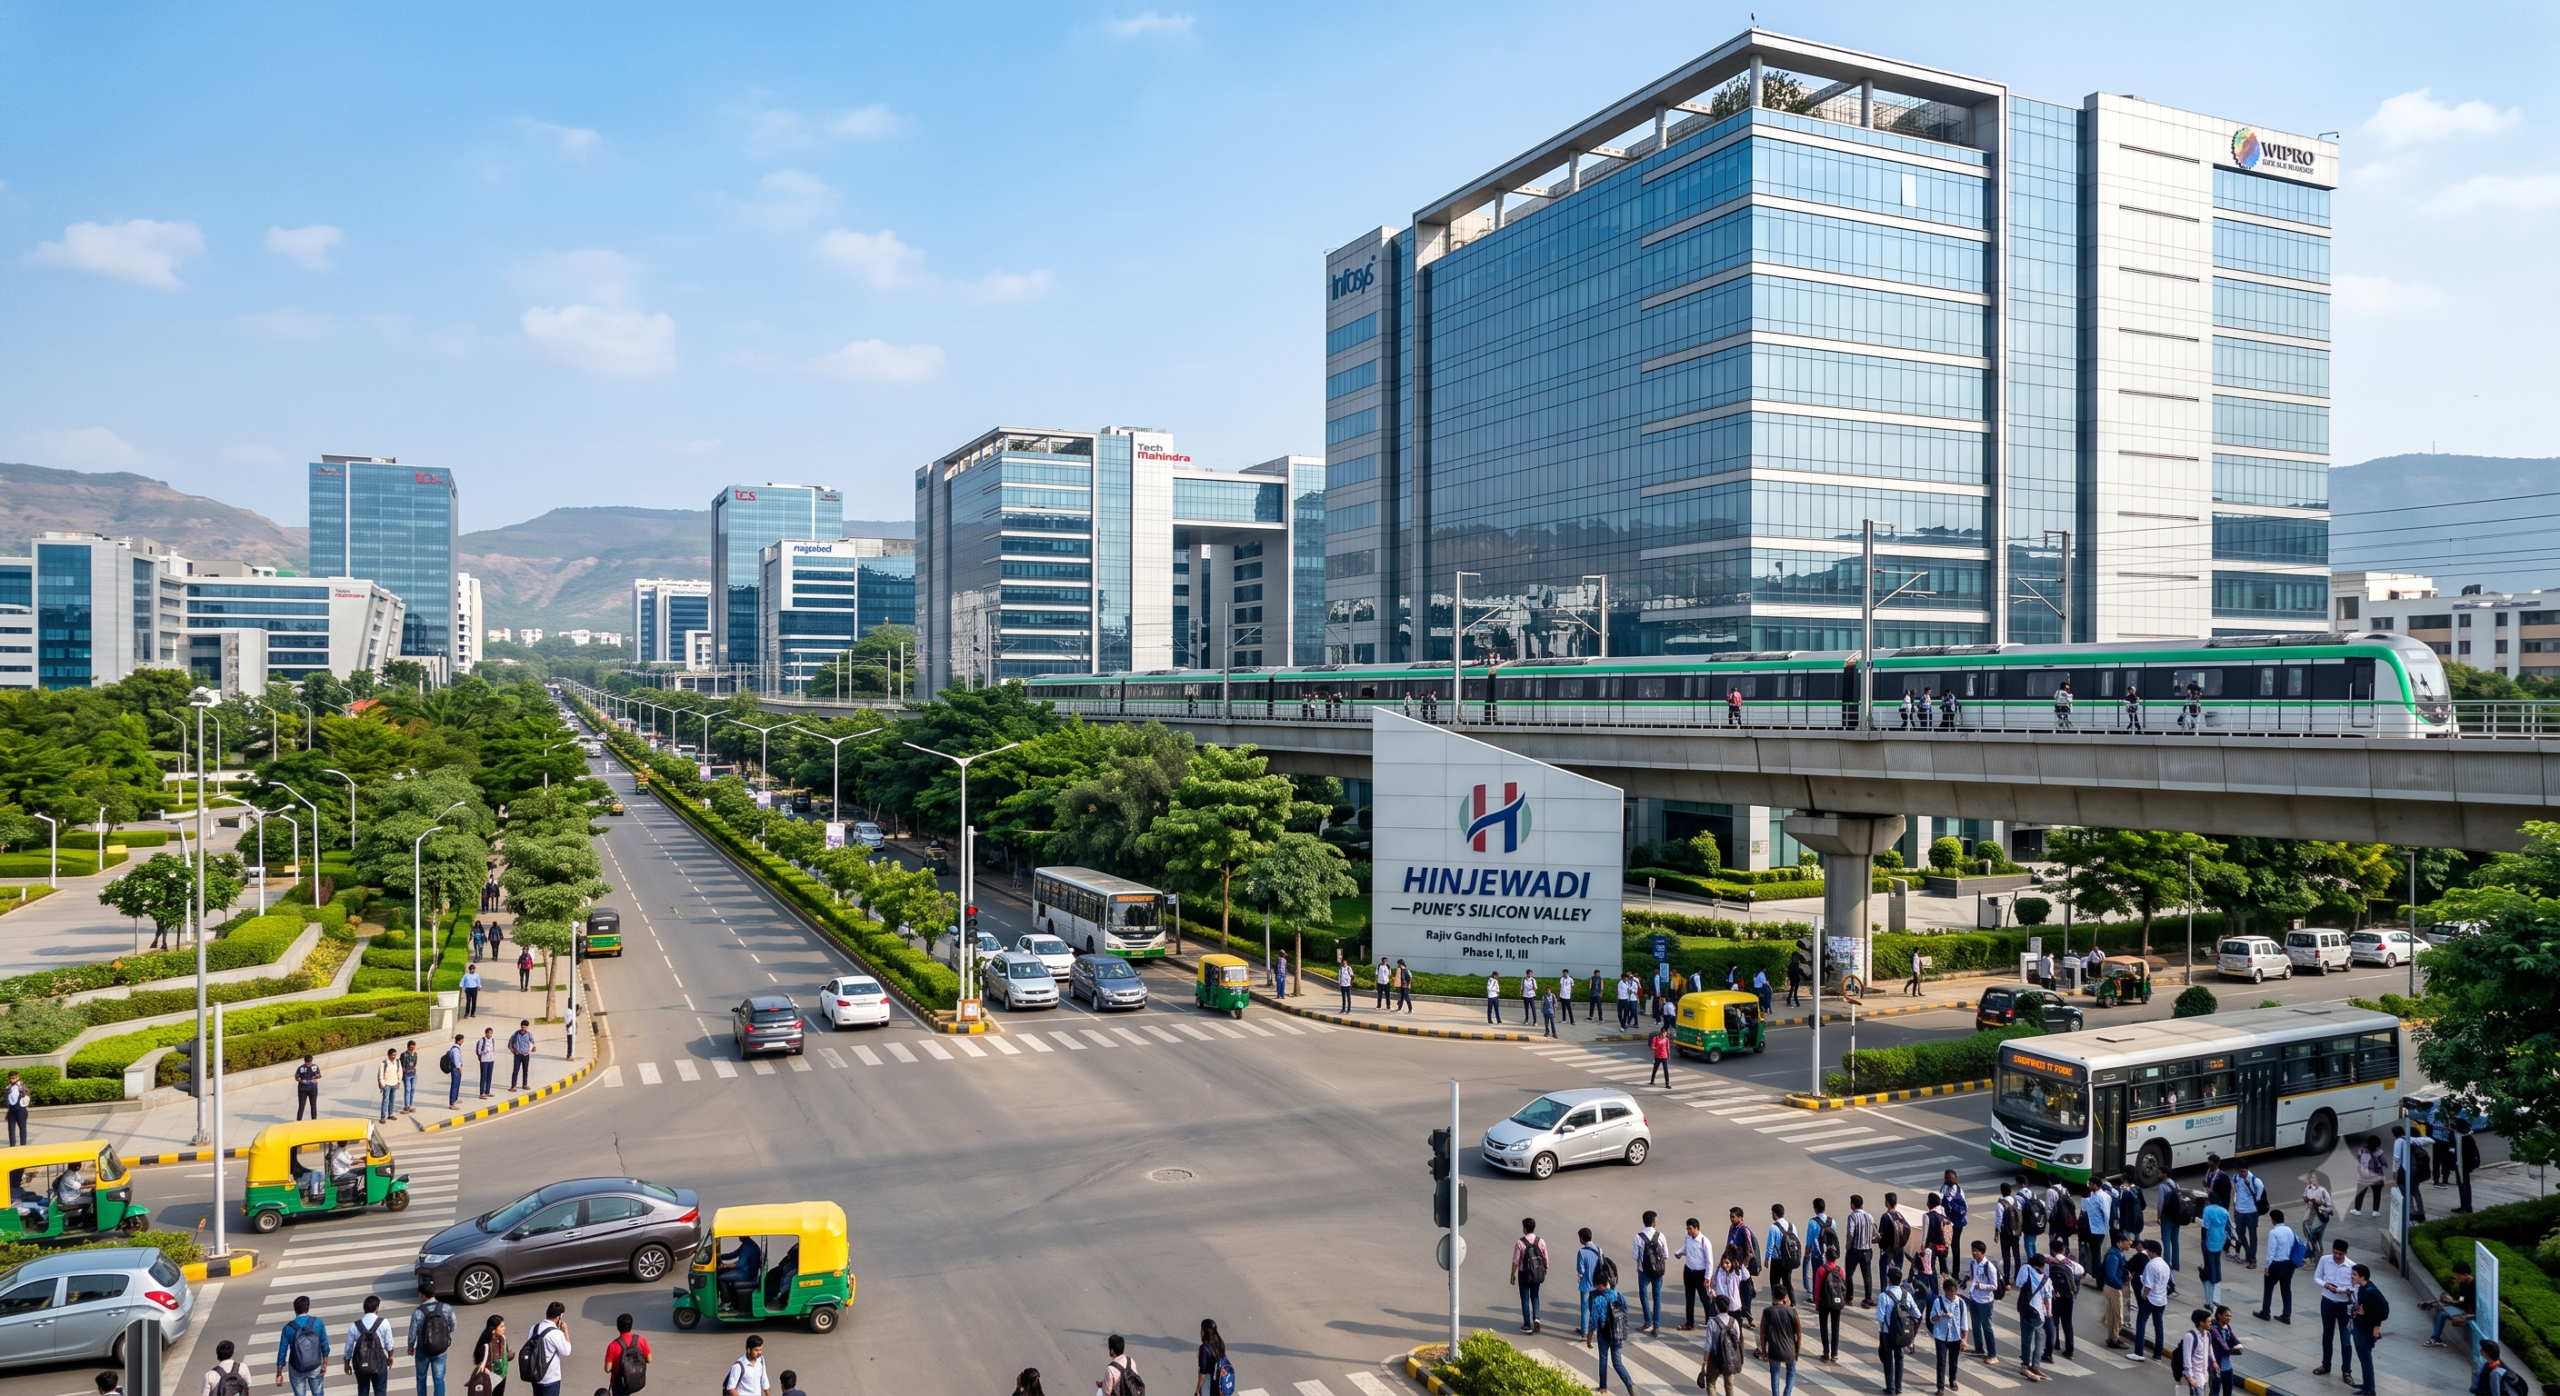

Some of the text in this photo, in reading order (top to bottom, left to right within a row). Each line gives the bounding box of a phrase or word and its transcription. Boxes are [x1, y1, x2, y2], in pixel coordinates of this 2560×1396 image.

[2261, 141, 2315, 166] WIPRO
[1137, 443, 1163, 452] Tech
[1137, 451, 1191, 462] Mahindra
[1403, 866, 1591, 899] HINJEWADI
[1412, 901, 1592, 922] PUNE'S SILICON VALLEY
[1426, 930, 1566, 946] Rajiv Gandhi Infotech Park
[1462, 946, 1494, 958] Phase
[1518, 949, 1529, 960] III
